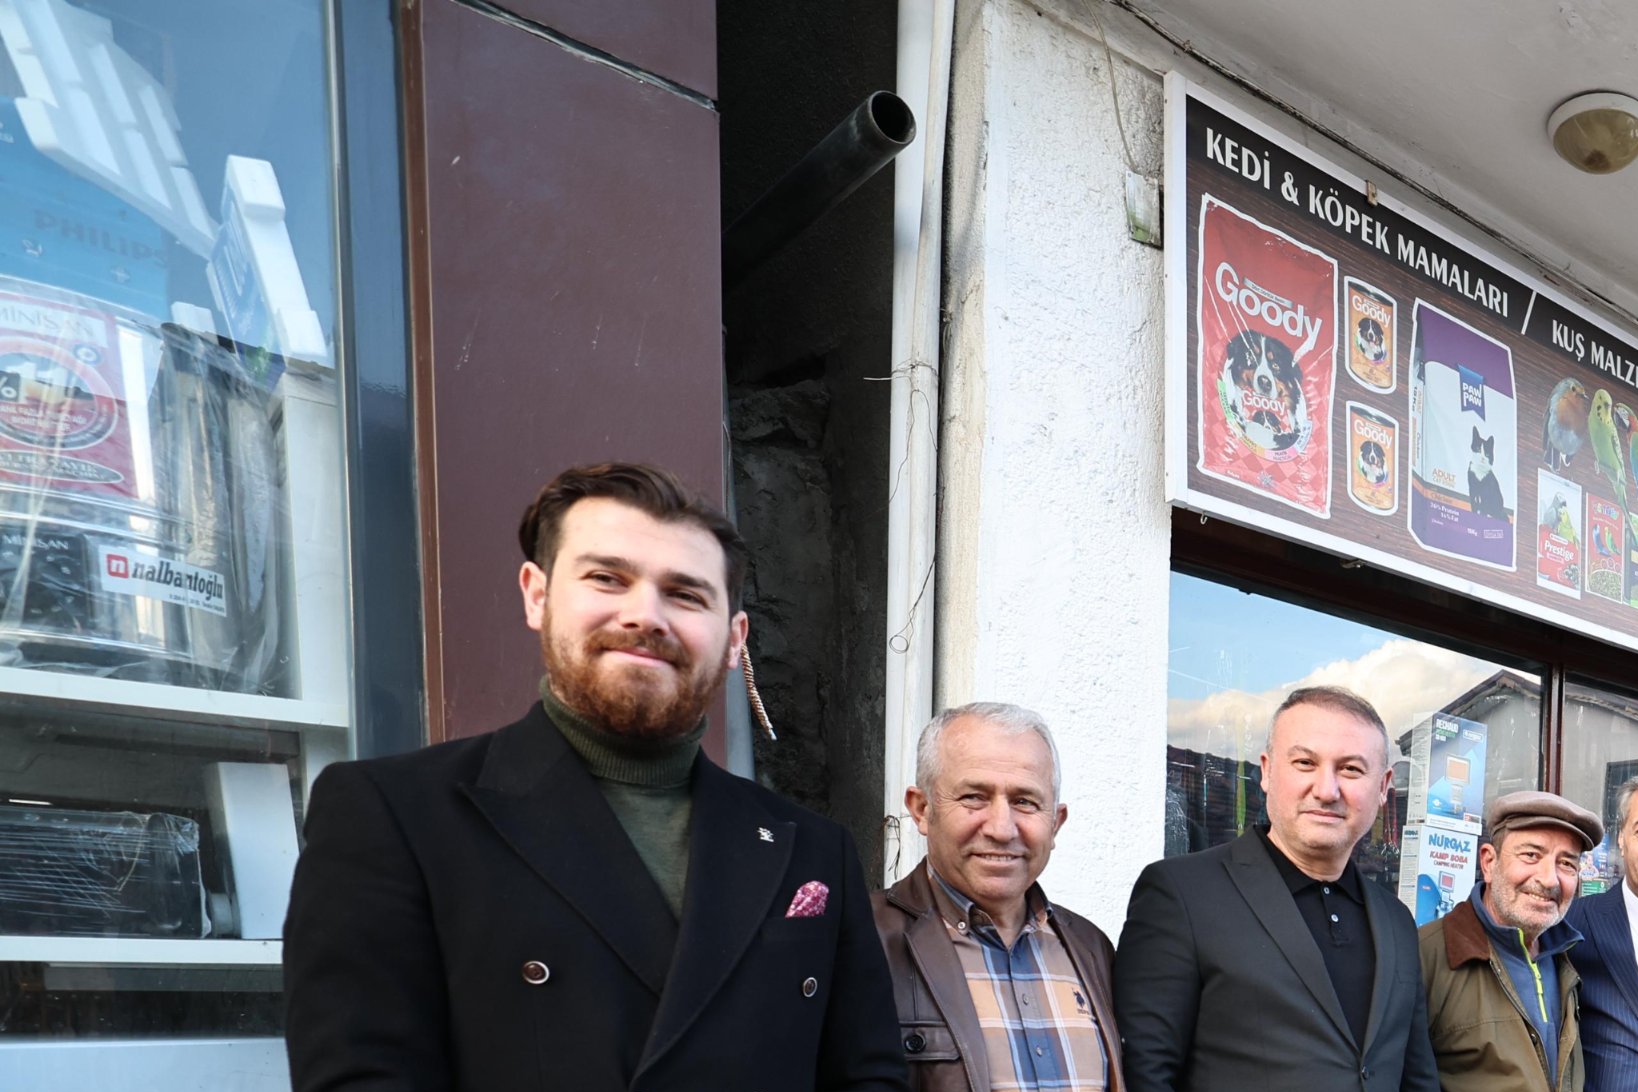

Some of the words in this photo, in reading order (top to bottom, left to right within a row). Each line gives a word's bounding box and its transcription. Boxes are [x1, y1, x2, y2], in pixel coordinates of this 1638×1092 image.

[1206, 127, 1270, 190] KEDİ
[1281, 171, 1300, 206] &
[1308, 184, 1390, 255] KÖPEK
[1397, 233, 1508, 318] MAMALARI
[1215, 262, 1323, 367] Goody
[1352, 294, 1391, 326] Goody
[1552, 319, 1585, 362] KUŞ
[1462, 382, 1482, 399] PAW
[1463, 391, 1482, 408] PAW
[1353, 419, 1392, 449] Goody
[1432, 468, 1457, 482] ADULT
[1544, 540, 1574, 562] Prestige
[132, 560, 224, 602] nalbantoğlu
[1428, 834, 1471, 853] NURGAZ
[1429, 850, 1450, 860] KAMP
